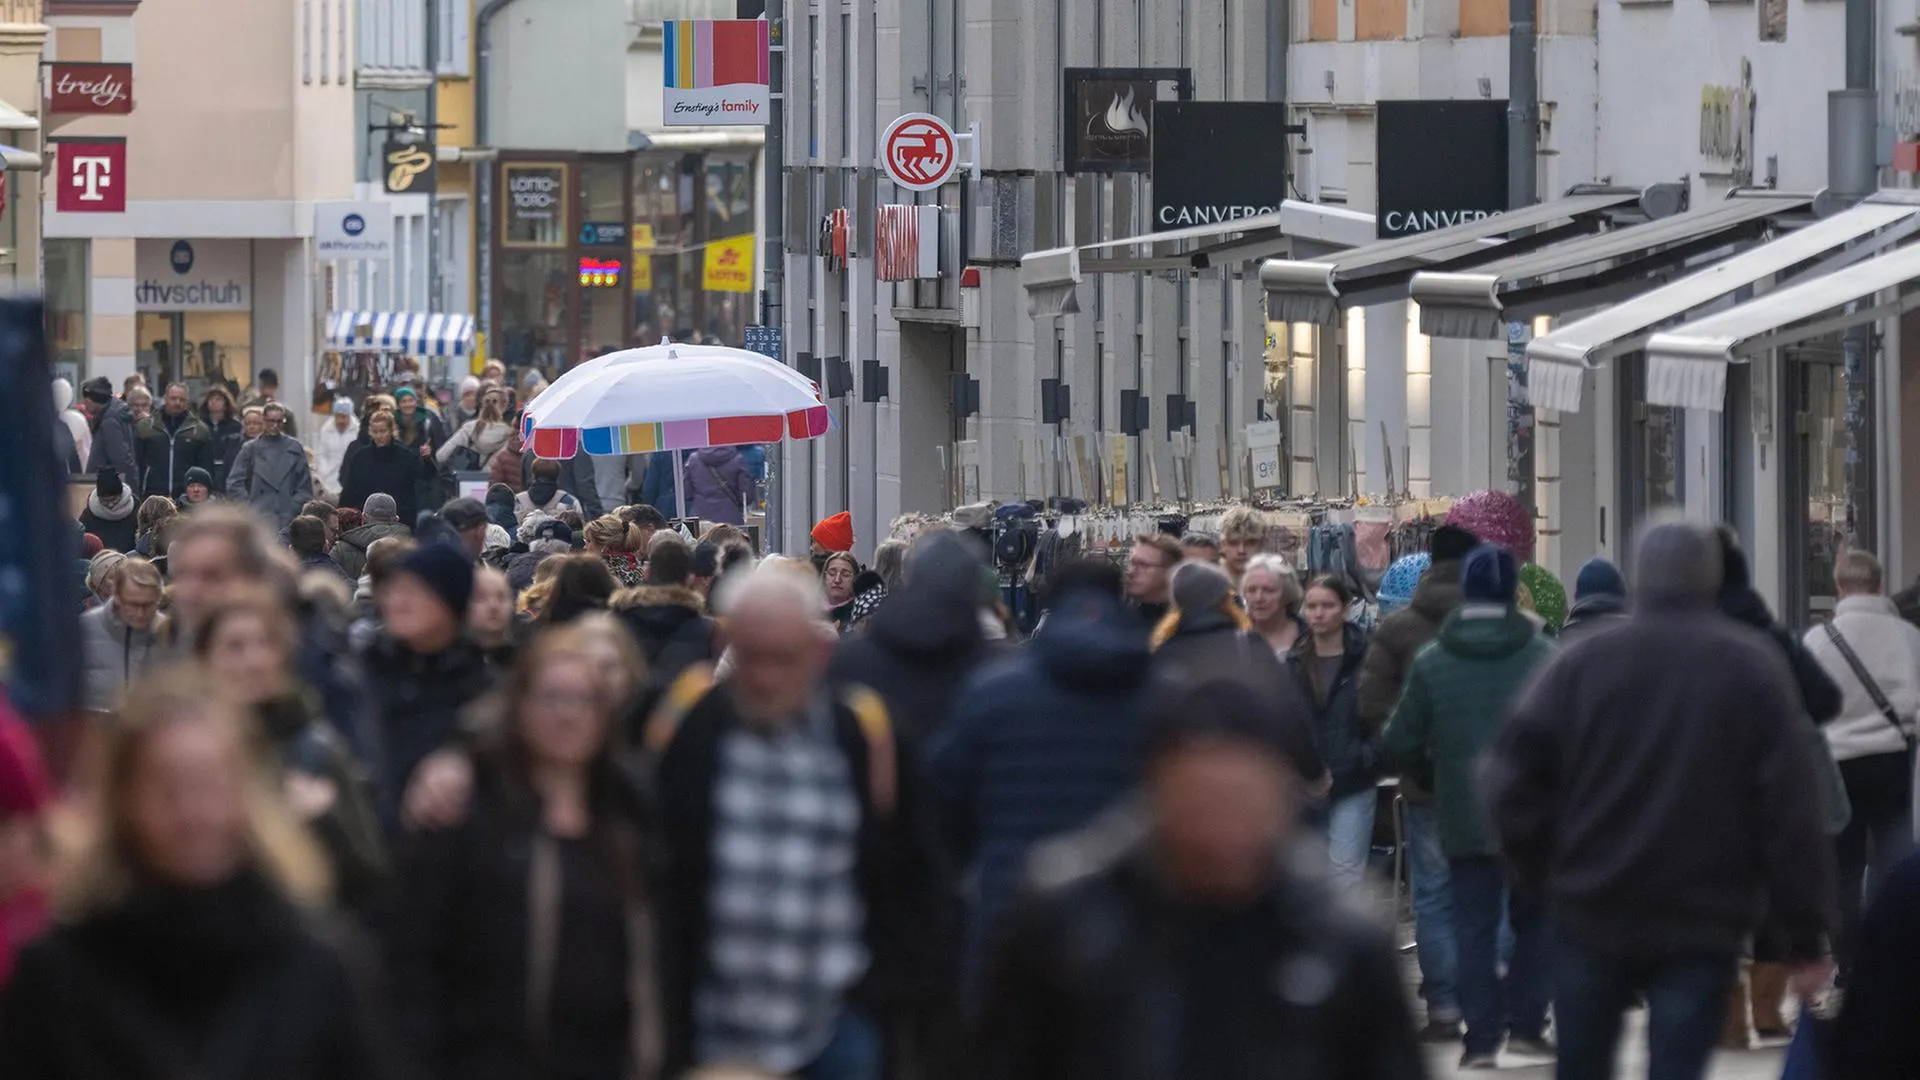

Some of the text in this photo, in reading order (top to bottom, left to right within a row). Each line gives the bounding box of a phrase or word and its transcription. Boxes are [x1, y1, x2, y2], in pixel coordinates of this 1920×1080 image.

[56, 73, 127, 106] tredy
[673, 99, 760, 117] Ernsting's family
[136, 278, 242, 305] ktivschuh
